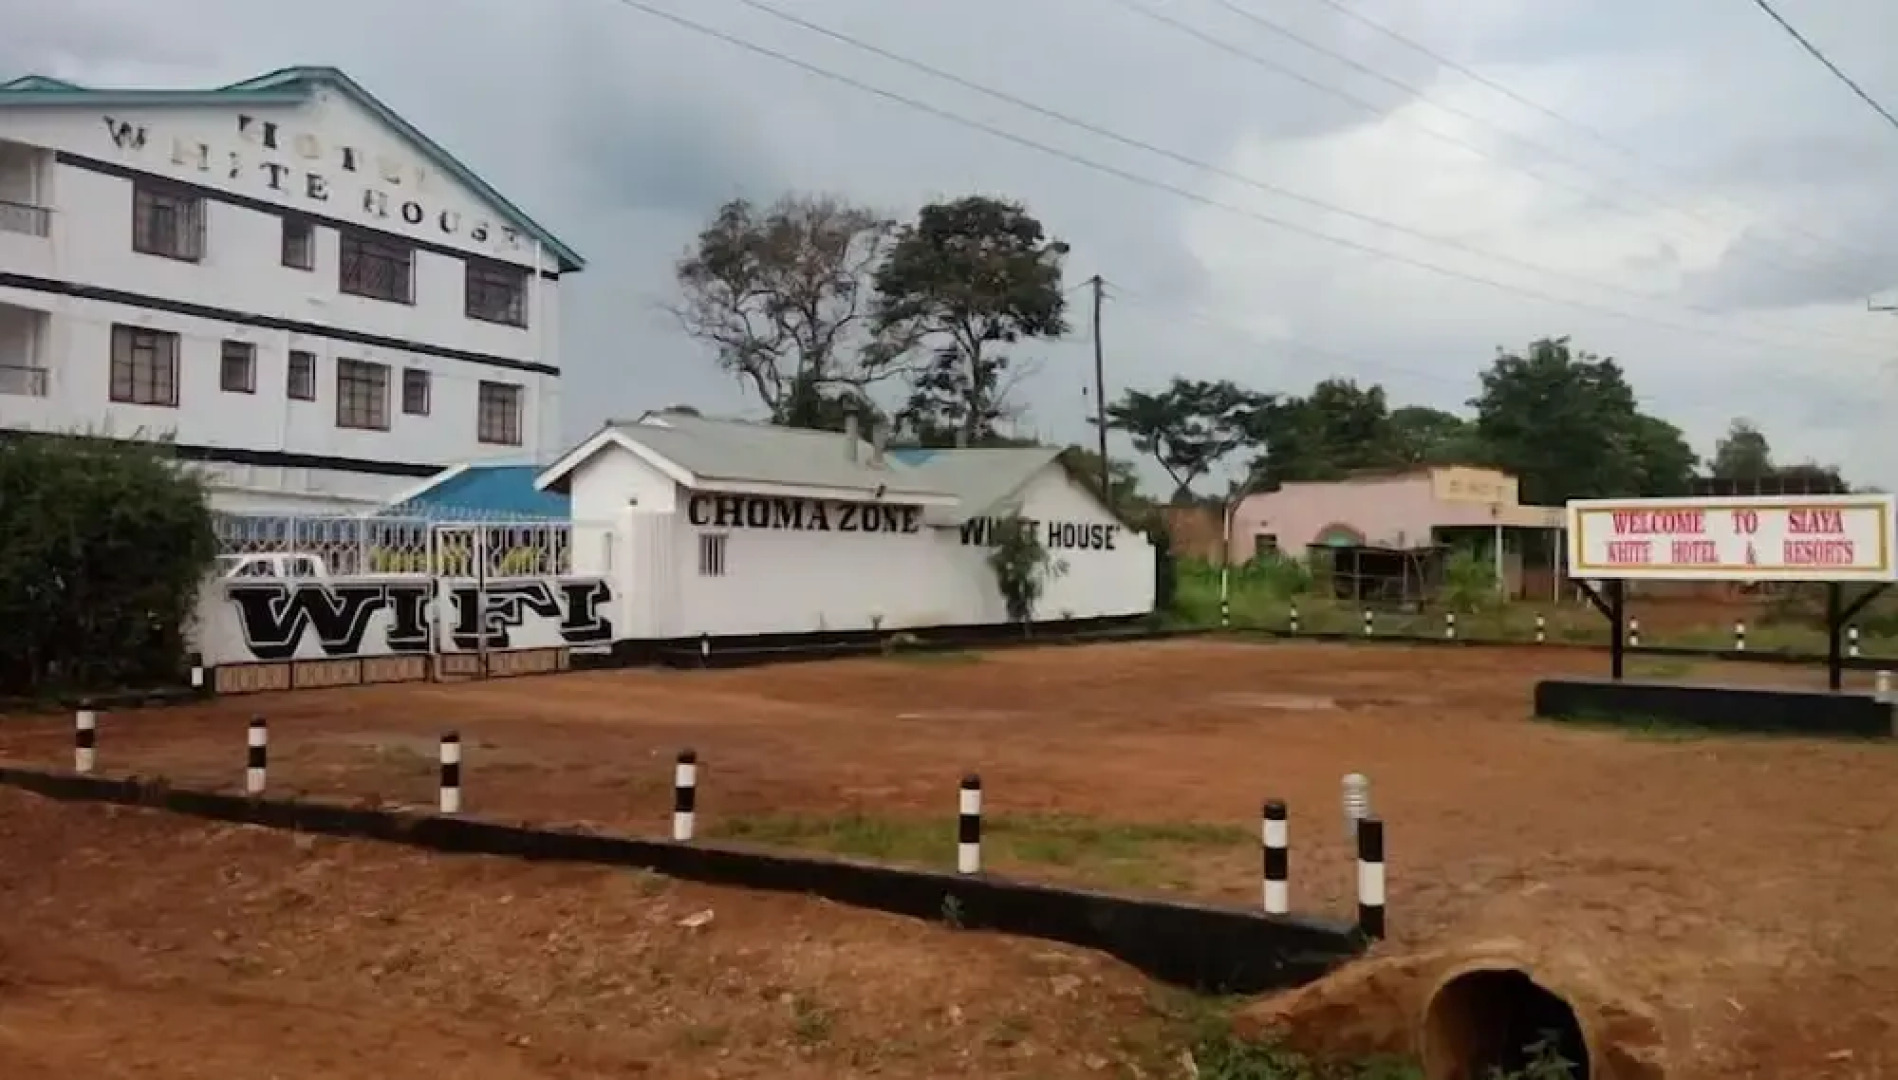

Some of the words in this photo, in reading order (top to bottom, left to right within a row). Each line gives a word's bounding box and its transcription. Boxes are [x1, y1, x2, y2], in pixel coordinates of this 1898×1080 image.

[688, 495, 831, 532] CHOMA
[837, 503, 923, 534] ZONE
[1611, 510, 1706, 535] WELCOME
[1731, 511, 1758, 535] TO
[1787, 510, 1844, 534] SIAYA
[959, 515, 1041, 549] WHTE
[1670, 540, 1720, 563] HOTEL
[1783, 540, 1854, 565] RESORTS
[226, 579, 613, 659] WIFI
